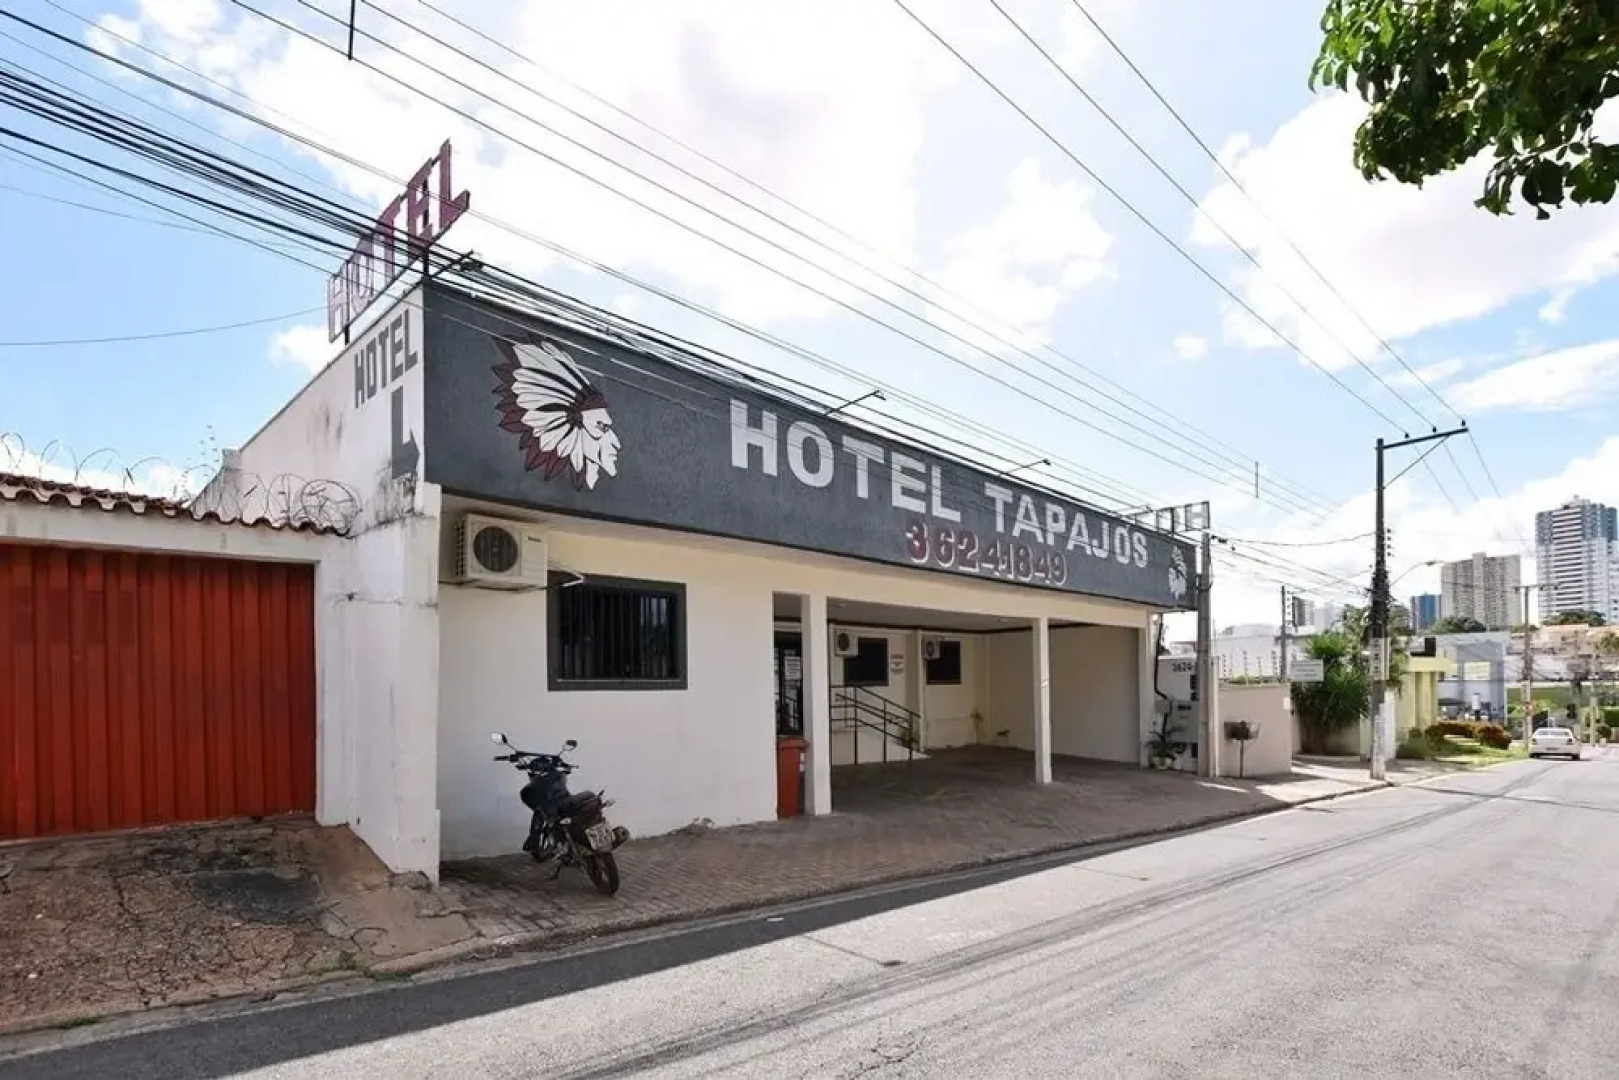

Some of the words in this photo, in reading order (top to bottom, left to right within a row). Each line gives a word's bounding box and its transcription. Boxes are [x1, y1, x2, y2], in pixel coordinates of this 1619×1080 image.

[327, 137, 470, 343] HOTEL
[354, 309, 418, 408] HOTEL
[730, 398, 961, 523] HOTEL
